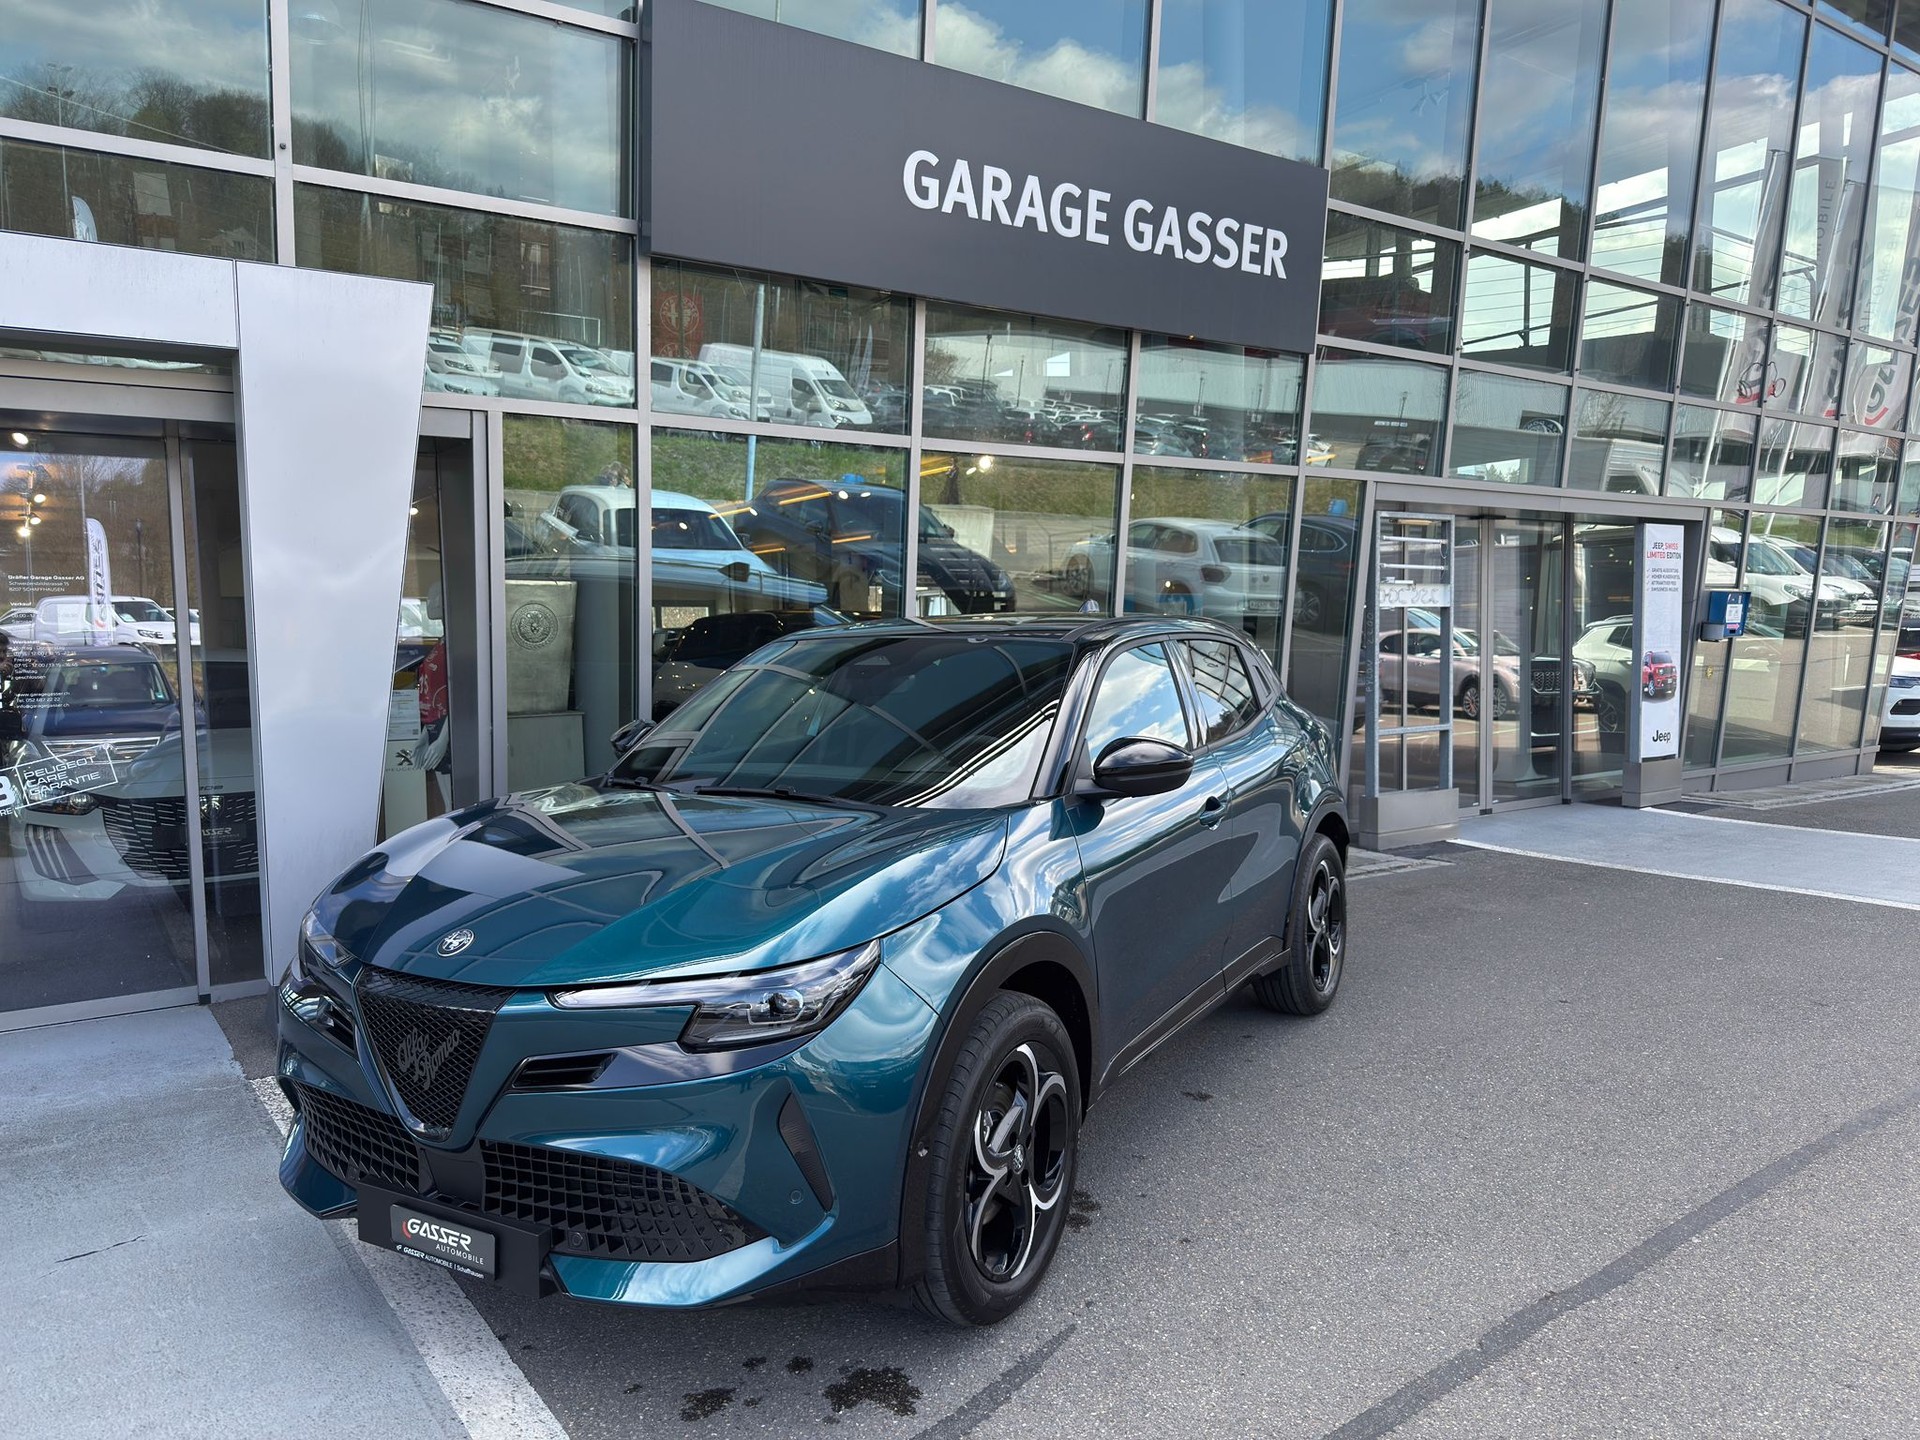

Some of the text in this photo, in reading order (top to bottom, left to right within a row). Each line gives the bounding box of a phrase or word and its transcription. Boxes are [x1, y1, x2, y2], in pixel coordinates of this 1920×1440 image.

[903, 149, 1289, 280] GARAGE GASSER
[1647, 551, 1682, 560] LIMITED EDITION
[1652, 729, 1671, 743] Jeep
[23, 755, 96, 779] PEUGEOT
[26, 771, 69, 788] CARE
[29, 771, 101, 796] GARANTIE
[407, 1218, 472, 1252] GASSER
[403, 1246, 485, 1279] GASSER AUTOMOBILE Schaffhausen
[436, 1243, 484, 1265] AUTOMOBILE
